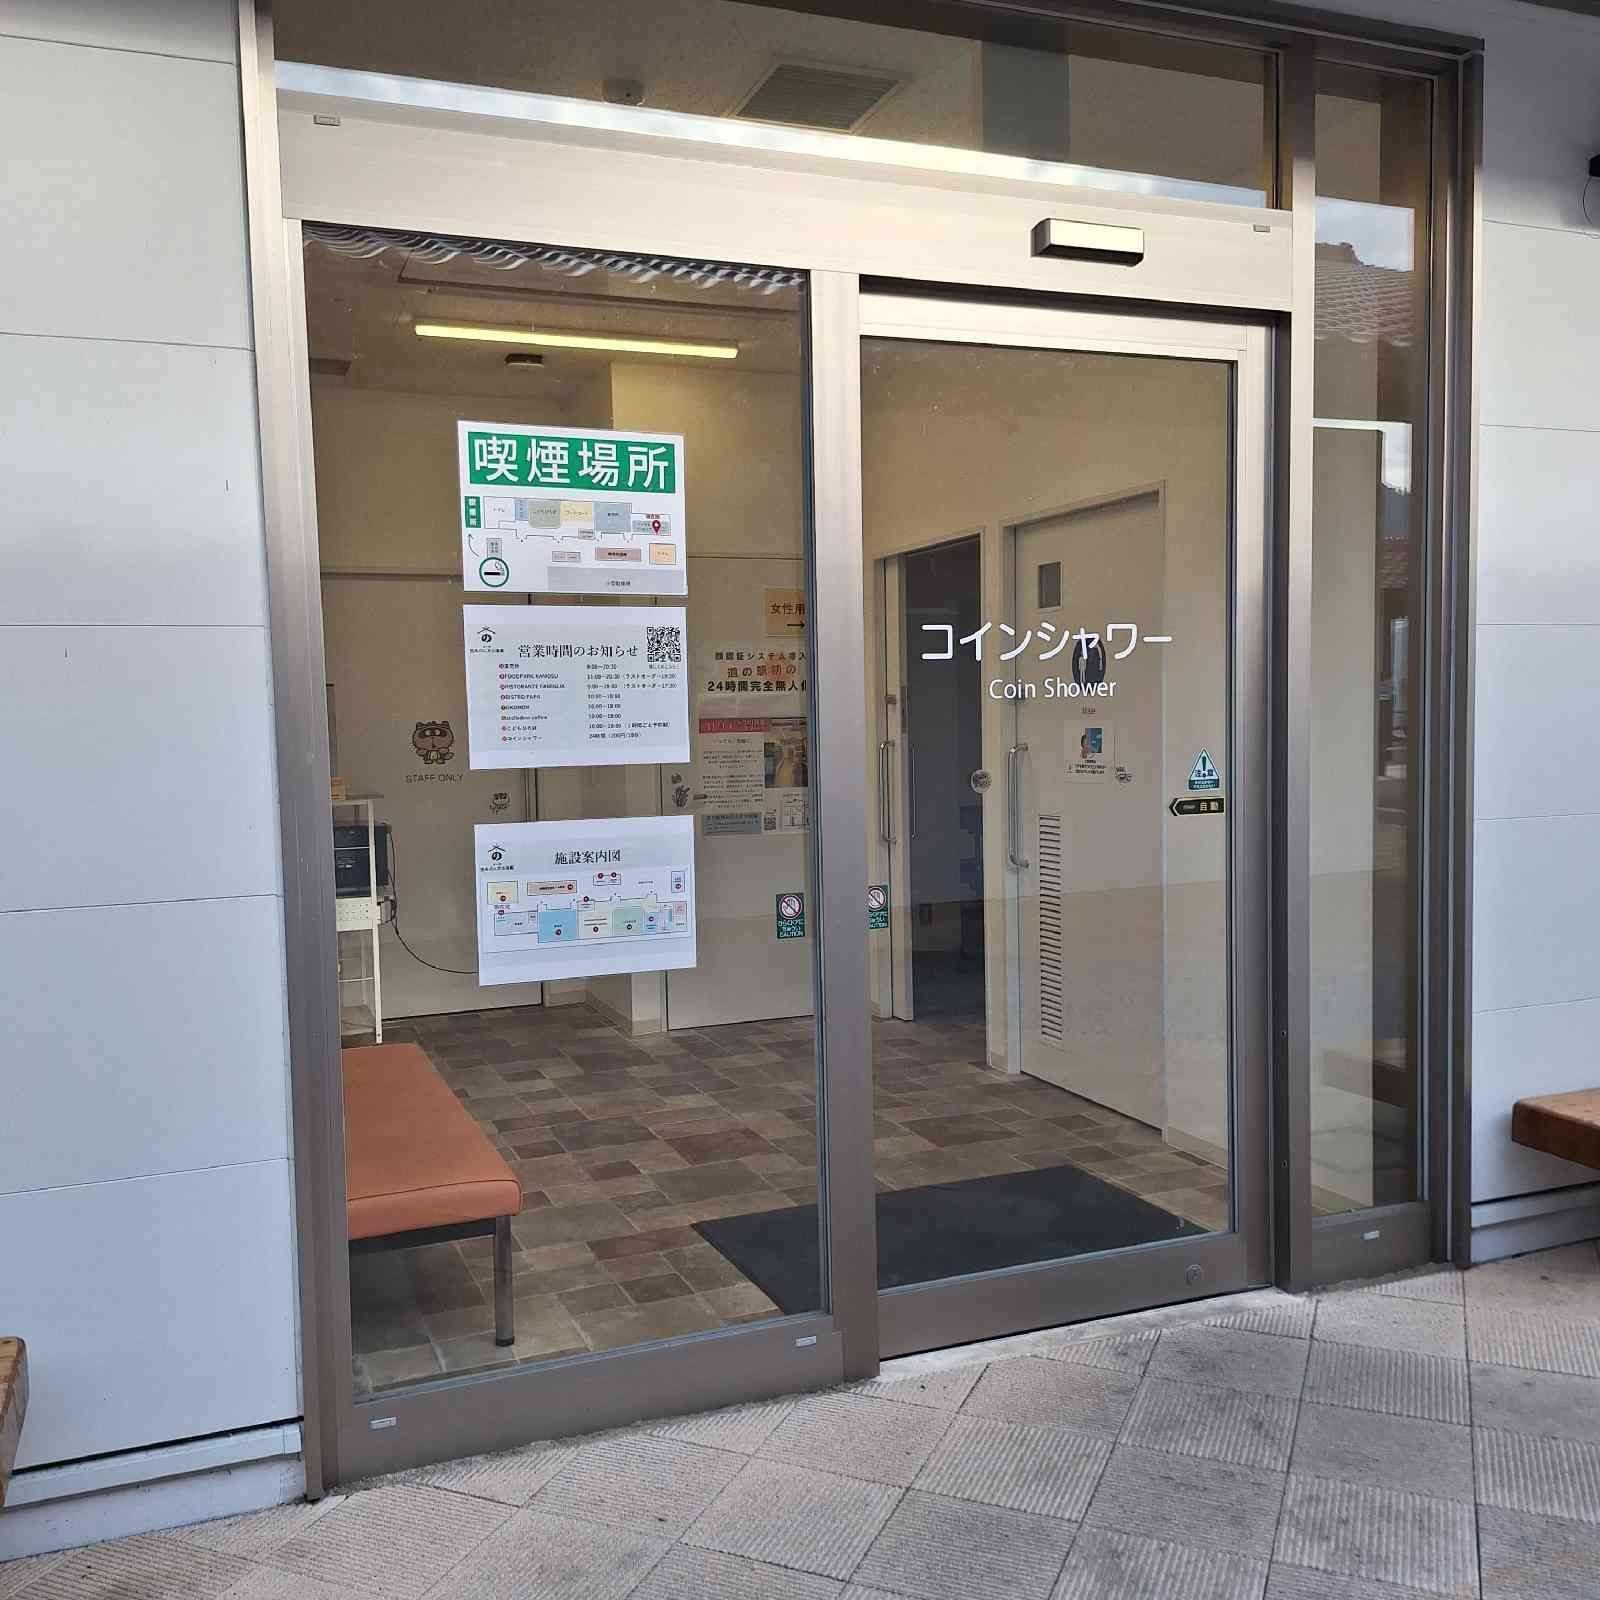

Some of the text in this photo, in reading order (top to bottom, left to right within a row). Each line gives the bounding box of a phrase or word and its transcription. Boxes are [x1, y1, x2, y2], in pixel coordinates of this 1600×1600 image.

[474, 436, 669, 489] 喫煙場所
[921, 621, 1173, 661] コインシャワー
[518, 644, 639, 659] 営業時間のお知らせ
[989, 677, 1118, 699] Coin Shower
[406, 773, 464, 784] STAFF ONLY
[554, 849, 622, 865] 施設案内図
